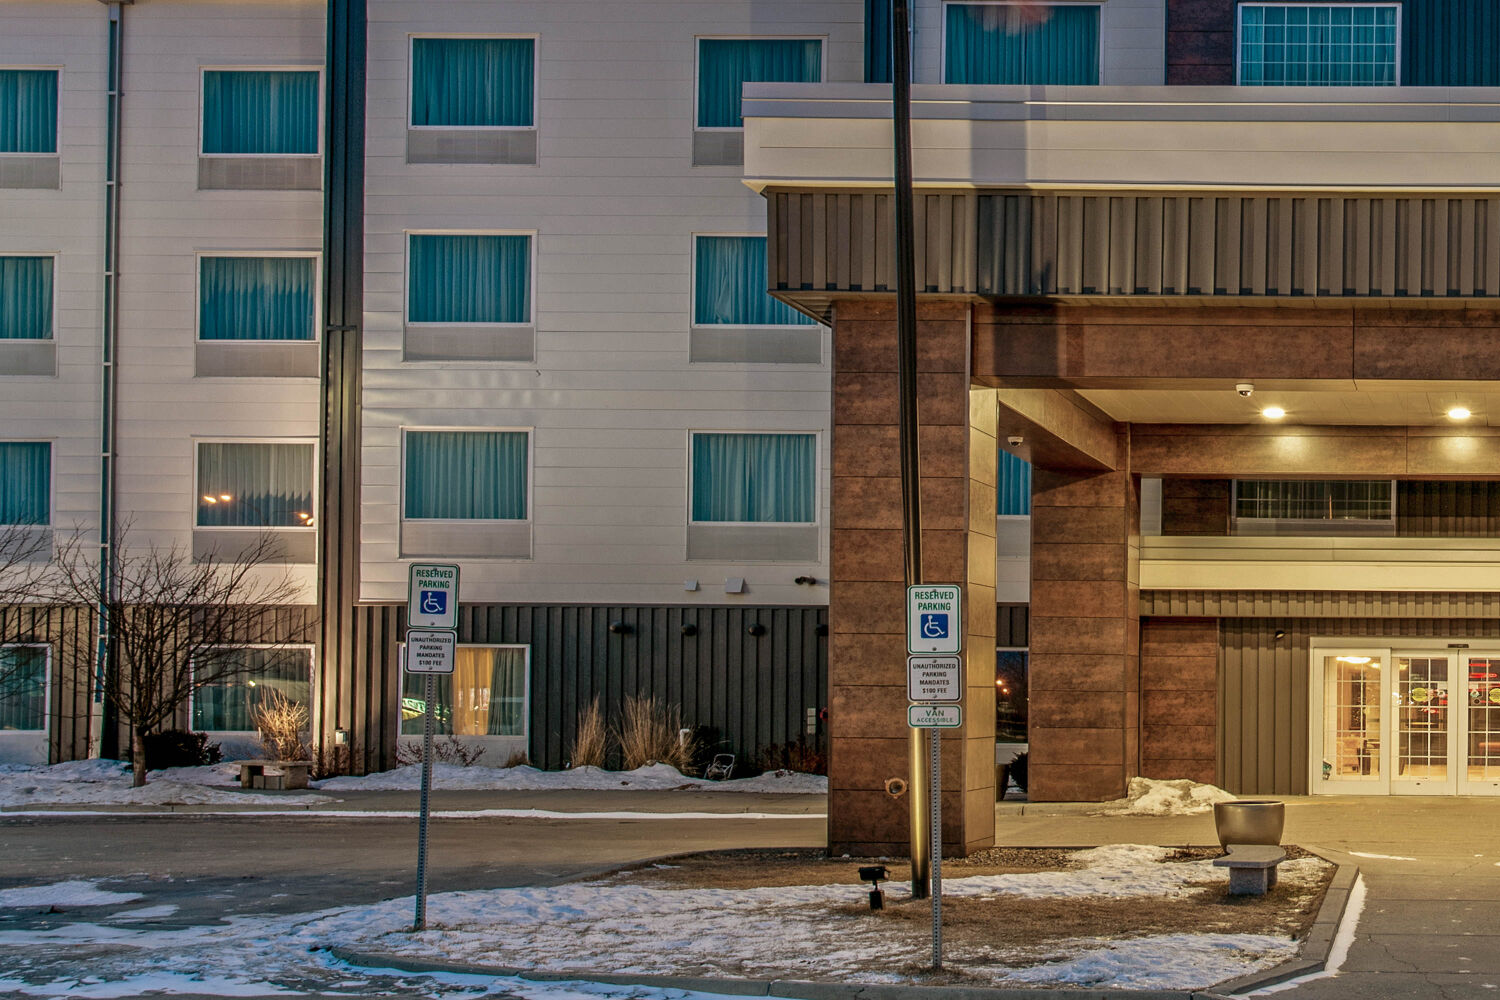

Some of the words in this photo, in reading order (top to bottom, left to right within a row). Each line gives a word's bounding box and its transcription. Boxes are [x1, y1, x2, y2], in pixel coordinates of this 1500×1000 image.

[416, 569, 453, 579] RESERVED
[418, 579, 450, 589] PARKING
[914, 591, 954, 600] RESERVED
[917, 602, 951, 611] PARKING
[925, 709, 945, 717] VAN
